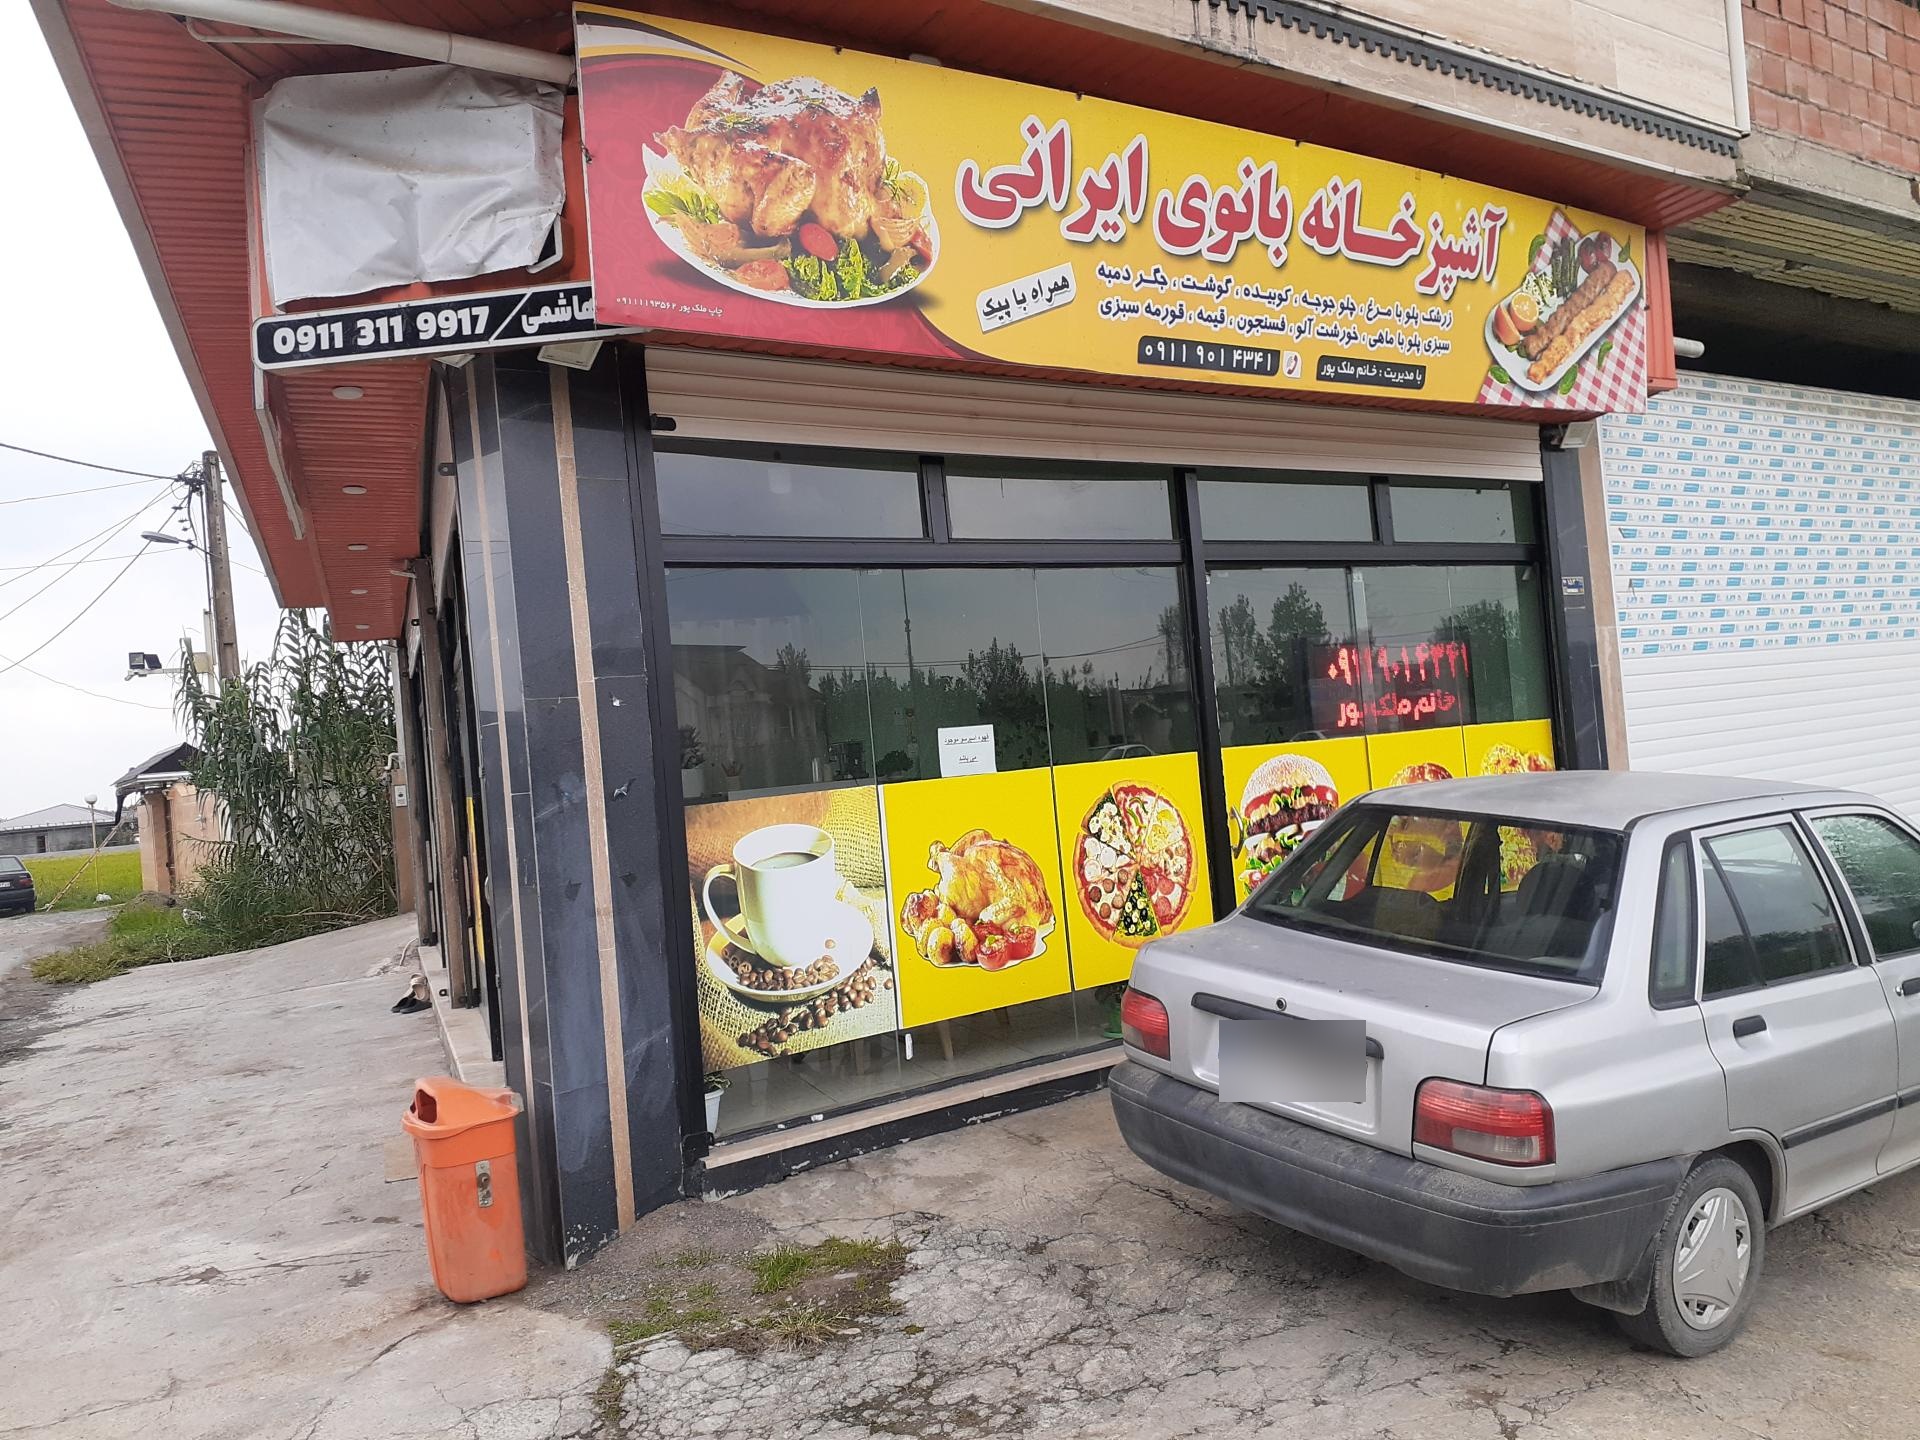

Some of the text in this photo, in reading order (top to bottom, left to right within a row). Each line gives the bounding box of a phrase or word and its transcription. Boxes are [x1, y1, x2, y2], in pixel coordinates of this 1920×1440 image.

[956, 116, 1506, 299] آشپزخانه بانوی ایرانی
[1097, 263, 1132, 284] دمبه
[1134, 267, 1169, 290] جگر
[691, 303, 707, 313] ملک
[982, 275, 1070, 321] همراه با پیک
[1100, 298, 1140, 318] سبزی
[1338, 296, 1356, 318] چلو
[679, 304, 690, 314] پور
[708, 306, 723, 318] چاپ
[1144, 301, 1185, 326] قورمه
[1395, 303, 1403, 323] با
[1404, 306, 1419, 326] پلو
[1421, 308, 1453, 328] زرشک
[273, 305, 490, 355] 0911 311 9917
[1316, 323, 1359, 346] خورشت
[1397, 331, 1405, 350] با
[1406, 333, 1421, 354] پلو
[1423, 337, 1450, 355] سبزی
[1145, 341, 1272, 372] ۰۹۱۱ ۹۰۱ ۴۳۴۱
[1320, 363, 1336, 379] پور
[1337, 361, 1355, 375] ملک
[1355, 363, 1378, 379] خانم
[1415, 368, 1423, 385] با
[1413, 688, 1456, 721] خانم
